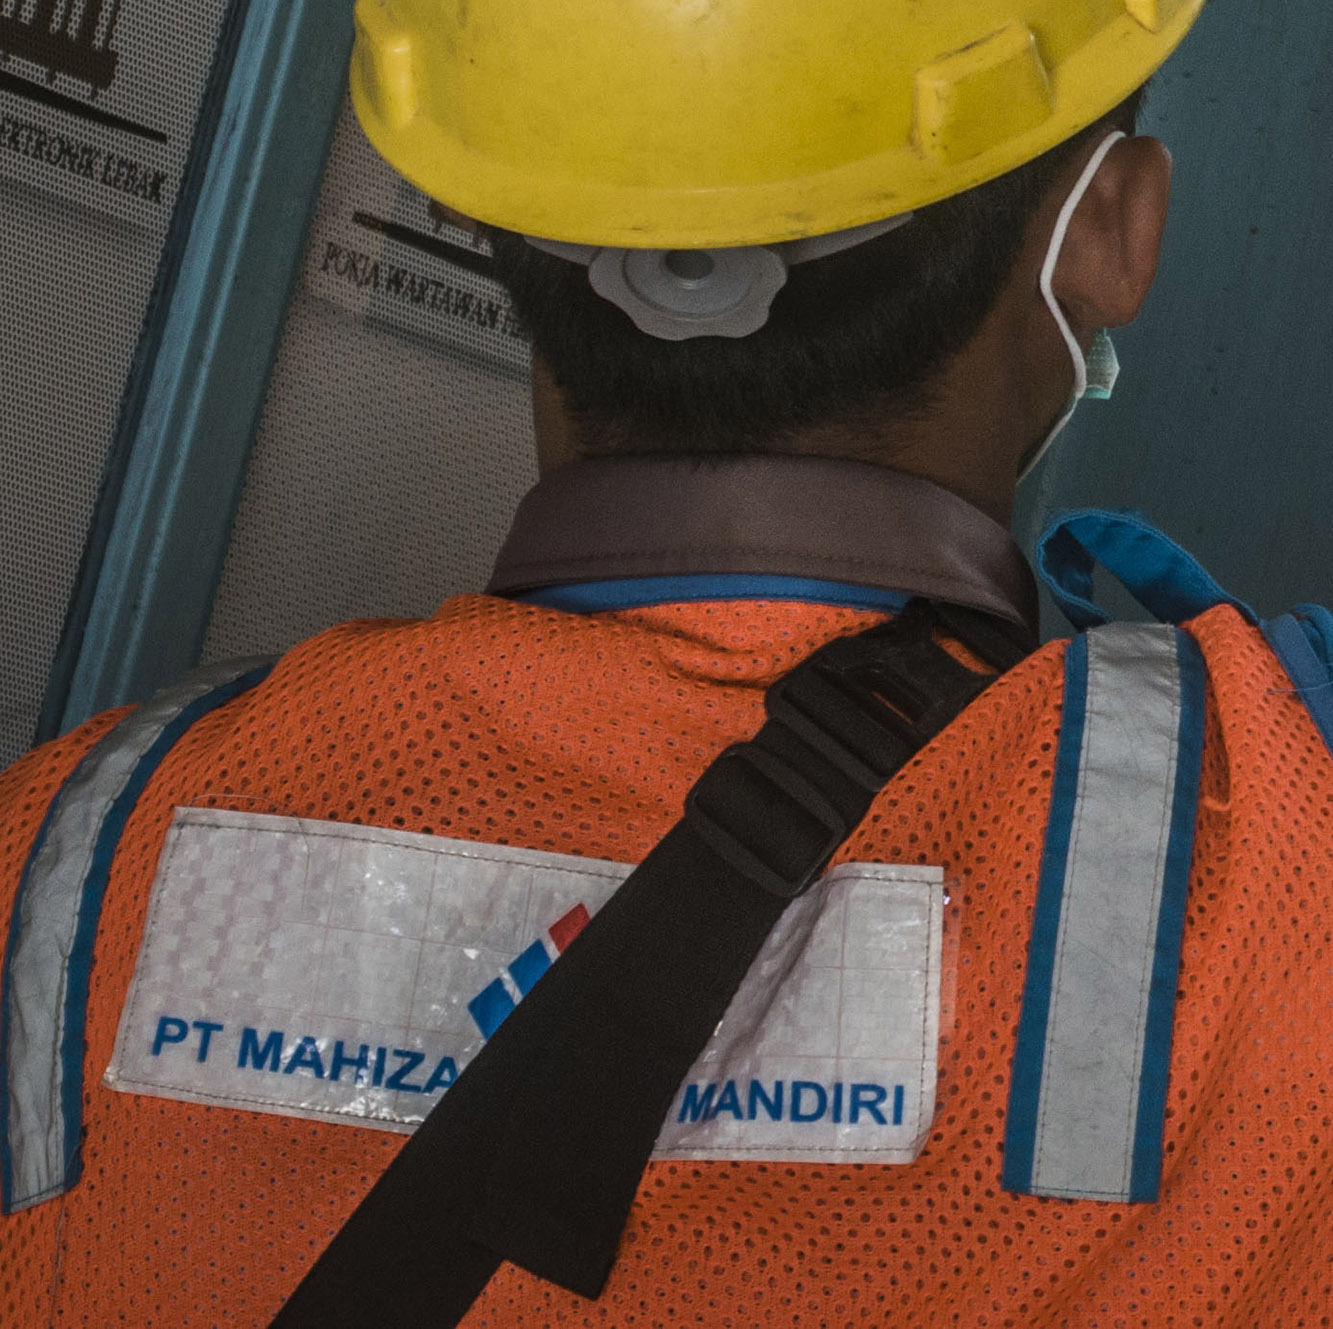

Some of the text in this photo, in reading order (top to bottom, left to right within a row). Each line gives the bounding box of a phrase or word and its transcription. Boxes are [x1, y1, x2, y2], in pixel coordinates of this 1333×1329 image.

[101, 153, 168, 204] LEBAK
[385, 264, 501, 329] WARTAWAN
[151, 1015, 905, 1126] PT MAHIZA MANDIRI
